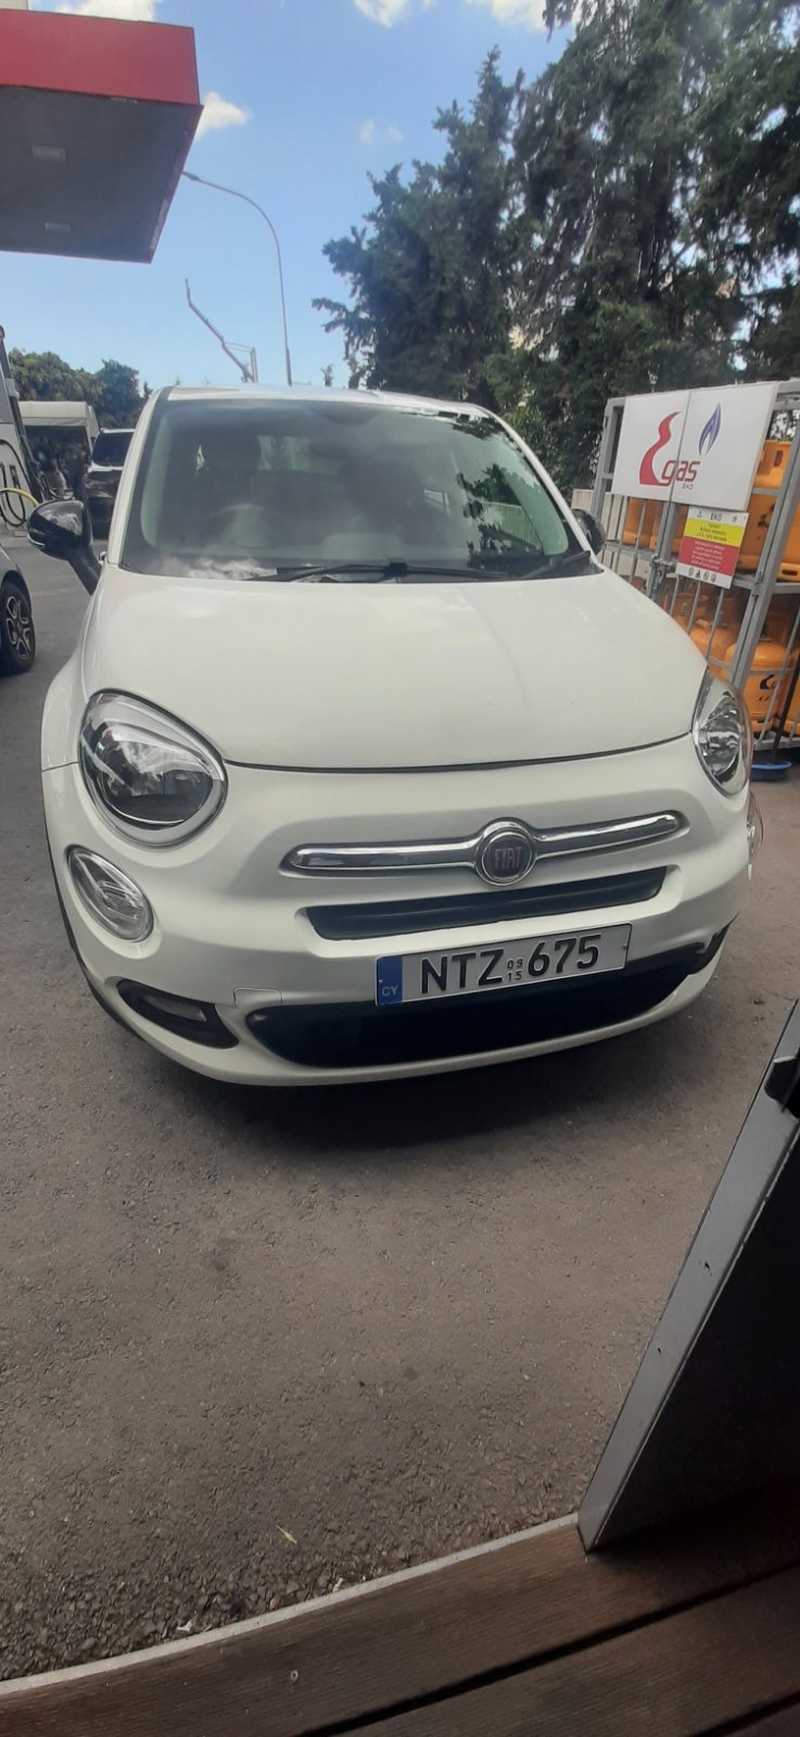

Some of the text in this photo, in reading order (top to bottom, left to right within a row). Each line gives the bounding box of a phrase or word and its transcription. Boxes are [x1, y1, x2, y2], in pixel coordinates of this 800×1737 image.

[659, 459, 702, 487] gas
[494, 846, 522, 870] FIAT
[421, 934, 602, 994] NTZ 675
[506, 958, 524, 971] 09
[507, 970, 522, 982] 15
[381, 984, 399, 997] CY
